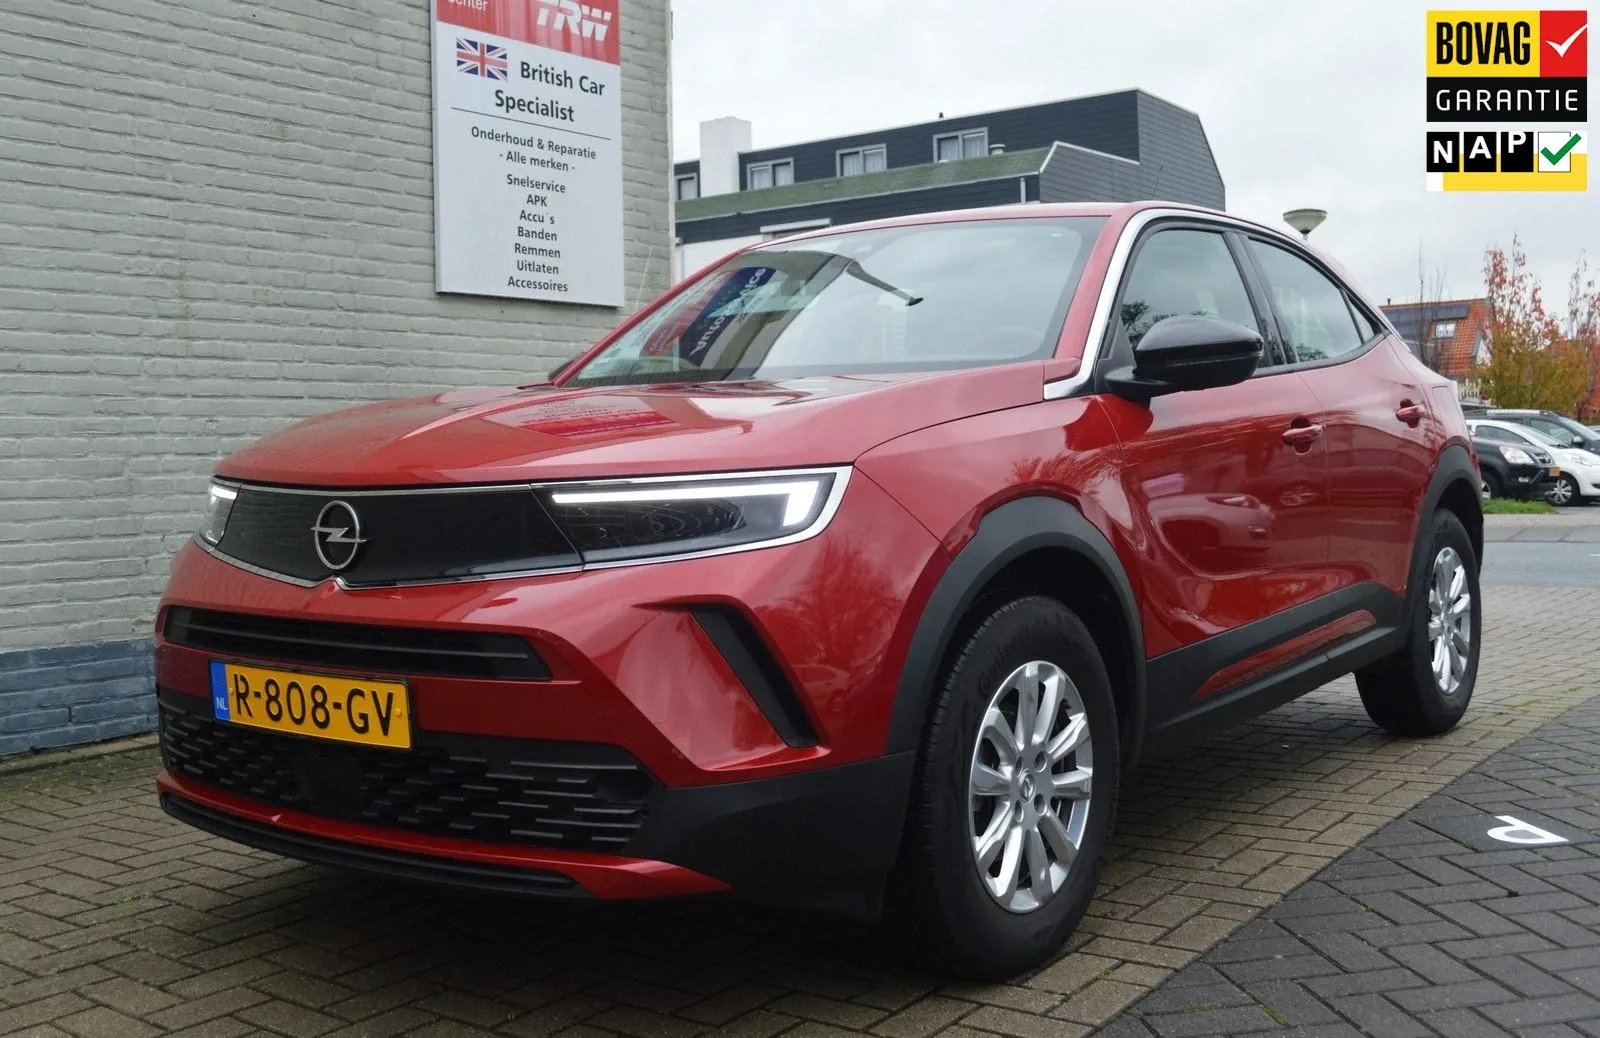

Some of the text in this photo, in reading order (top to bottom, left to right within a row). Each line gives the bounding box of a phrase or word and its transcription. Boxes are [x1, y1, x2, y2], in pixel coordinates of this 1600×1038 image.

[447, 0, 488, 12] enter
[537, 0, 612, 42] TRW
[520, 61, 605, 96] British Car
[495, 90, 574, 122] Specialist
[471, 126, 597, 160] Onderhoud & Reparatie
[506, 151, 526, 164] Alle
[530, 157, 569, 171] merken
[507, 174, 566, 193] Snelservice
[526, 194, 548, 207] APK
[517, 226, 558, 241] Banden
[514, 243, 561, 258] Remmen
[516, 260, 559, 275] Uitlaten
[507, 276, 569, 292] Accessoires
[215, 673, 394, 736] NL R-808-GV
